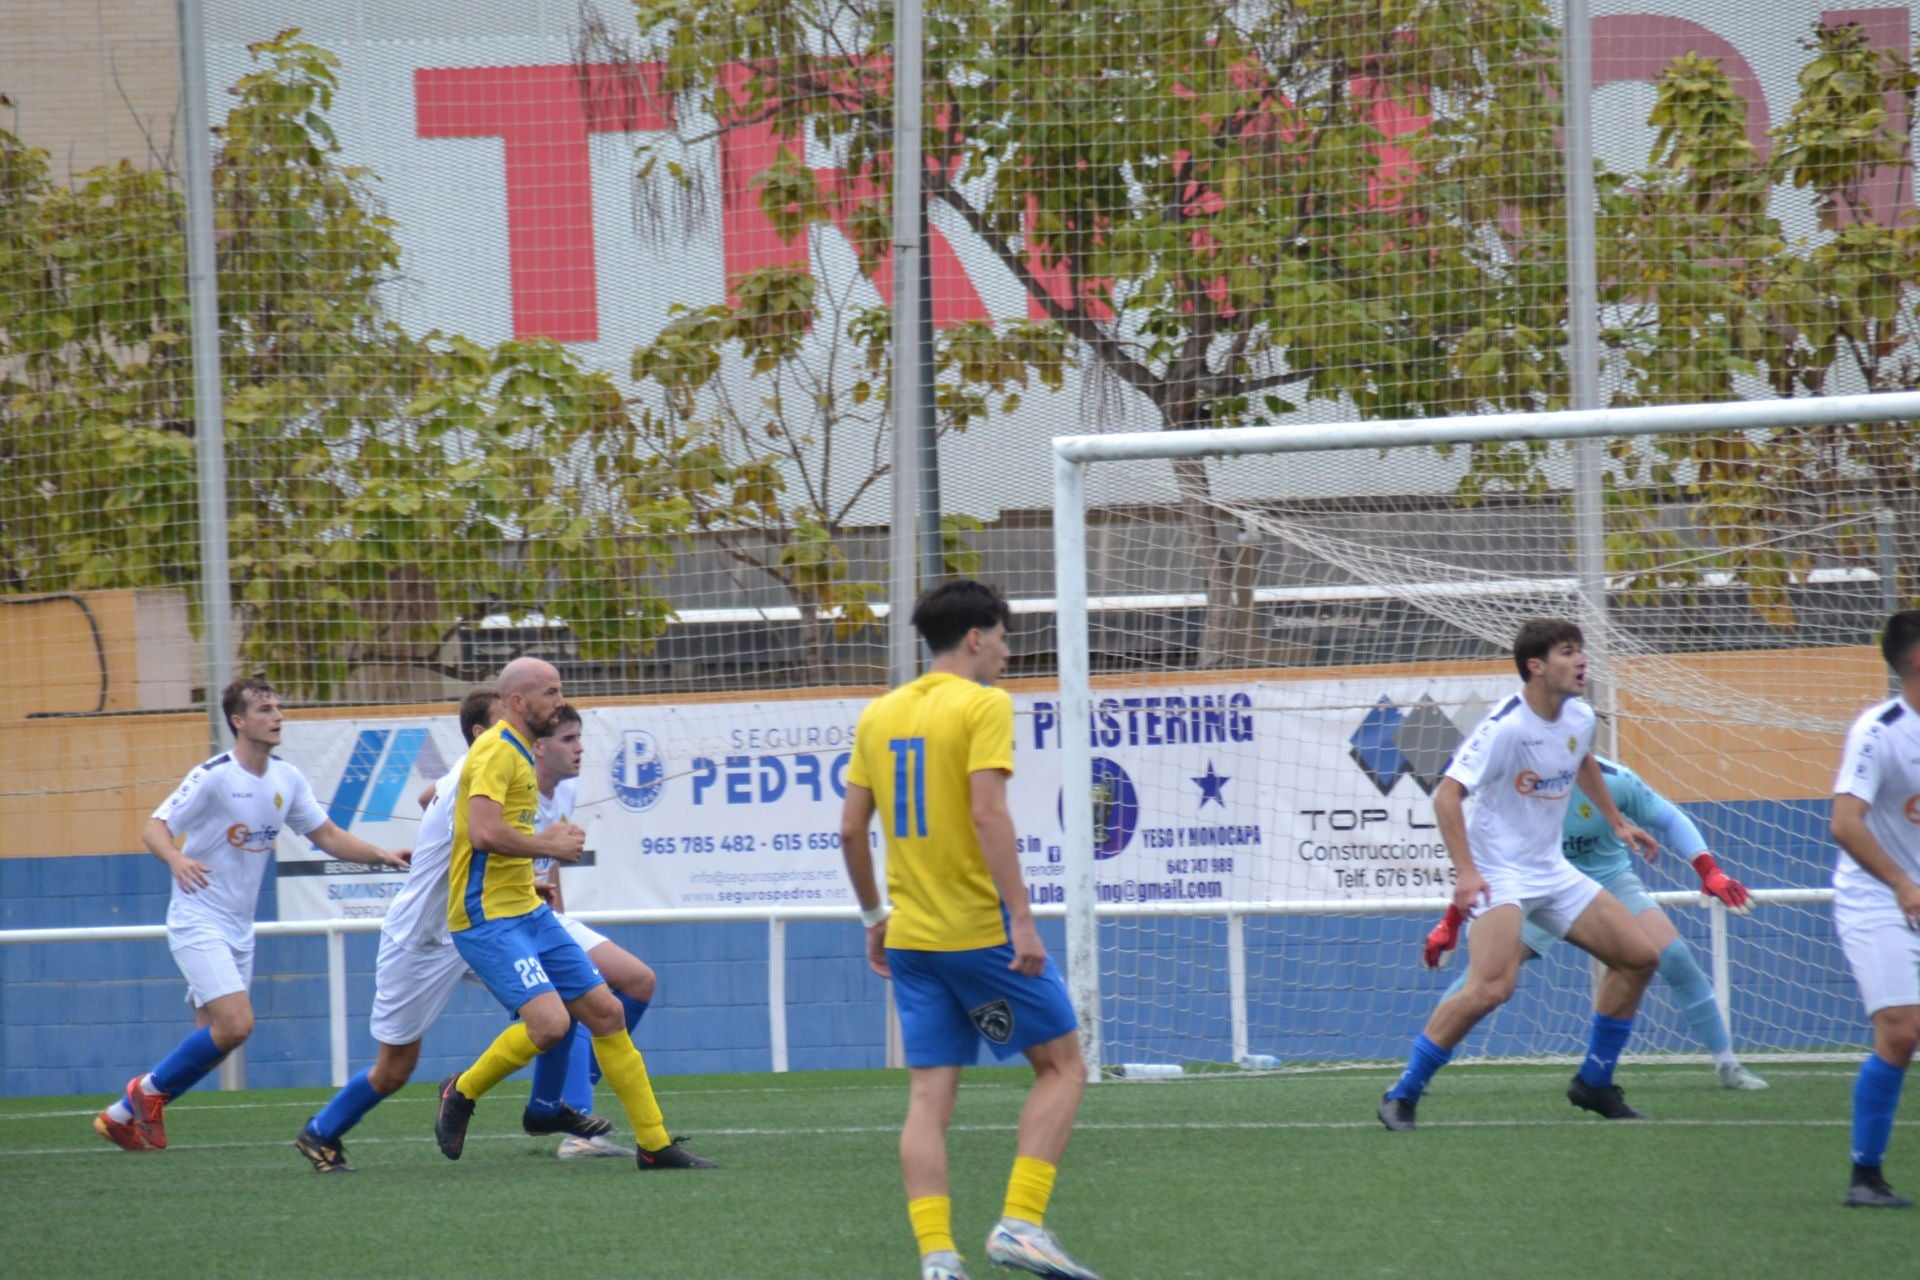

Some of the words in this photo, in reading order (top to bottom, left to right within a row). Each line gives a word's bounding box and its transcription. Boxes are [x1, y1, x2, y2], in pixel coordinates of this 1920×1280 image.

[731, 726, 857, 750] SEGUROS
[889, 737, 927, 838] 11
[1300, 808, 1389, 831] TOP
[641, 837, 677, 855] 965
[683, 836, 715, 854] 785
[720, 835, 756, 853] 482
[772, 833, 803, 851] 615
[807, 832, 844, 850] 650
[1142, 830, 1174, 848] YESO
[1299, 838, 1452, 862] Construccione
[1374, 869, 1408, 888] 676
[1412, 868, 1444, 887] 514
[681, 888, 848, 904] www.segurospedros.net
[513, 957, 550, 990] 23
